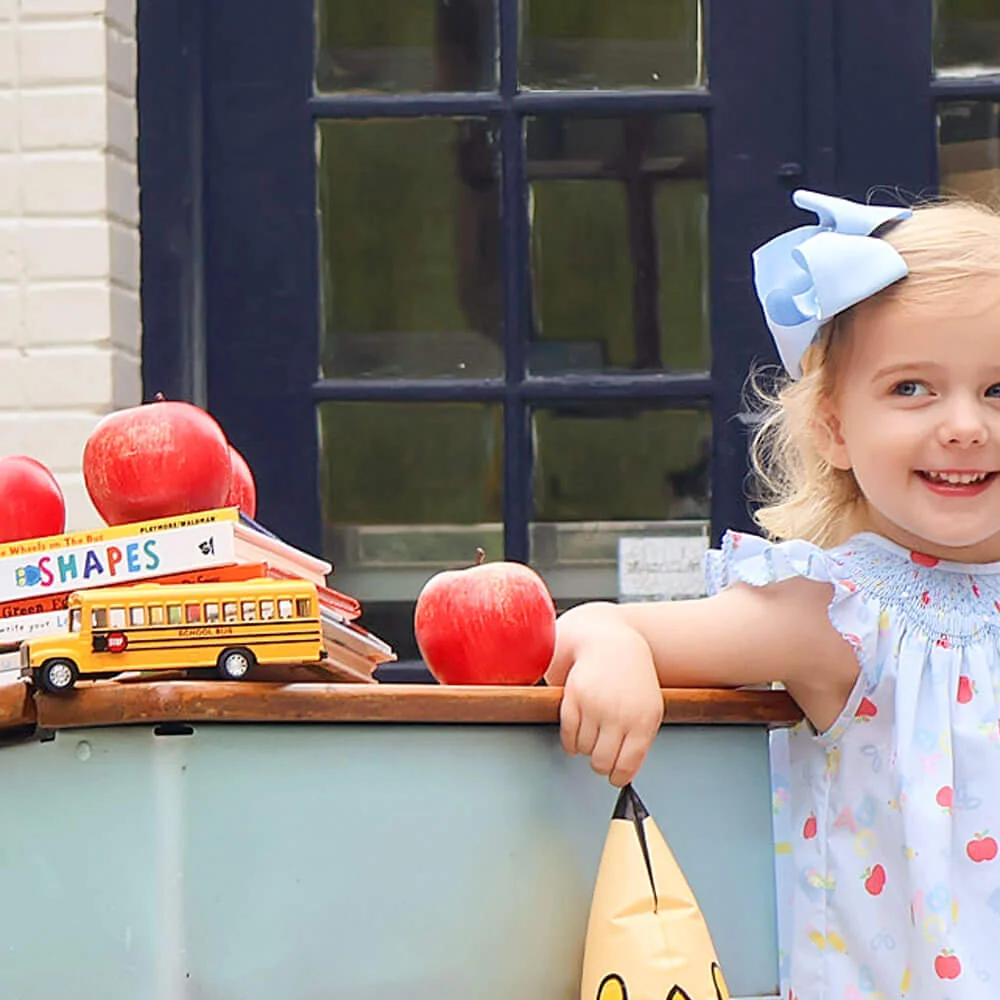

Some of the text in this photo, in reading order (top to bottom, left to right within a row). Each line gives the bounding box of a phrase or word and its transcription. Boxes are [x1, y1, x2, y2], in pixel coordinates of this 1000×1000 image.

[9, 541, 46, 554] Wheels
[64, 537, 83, 546] The
[38, 540, 160, 587] SHAPES
[2, 604, 44, 618] Green
[178, 627, 233, 637] SCHOOL BUS
